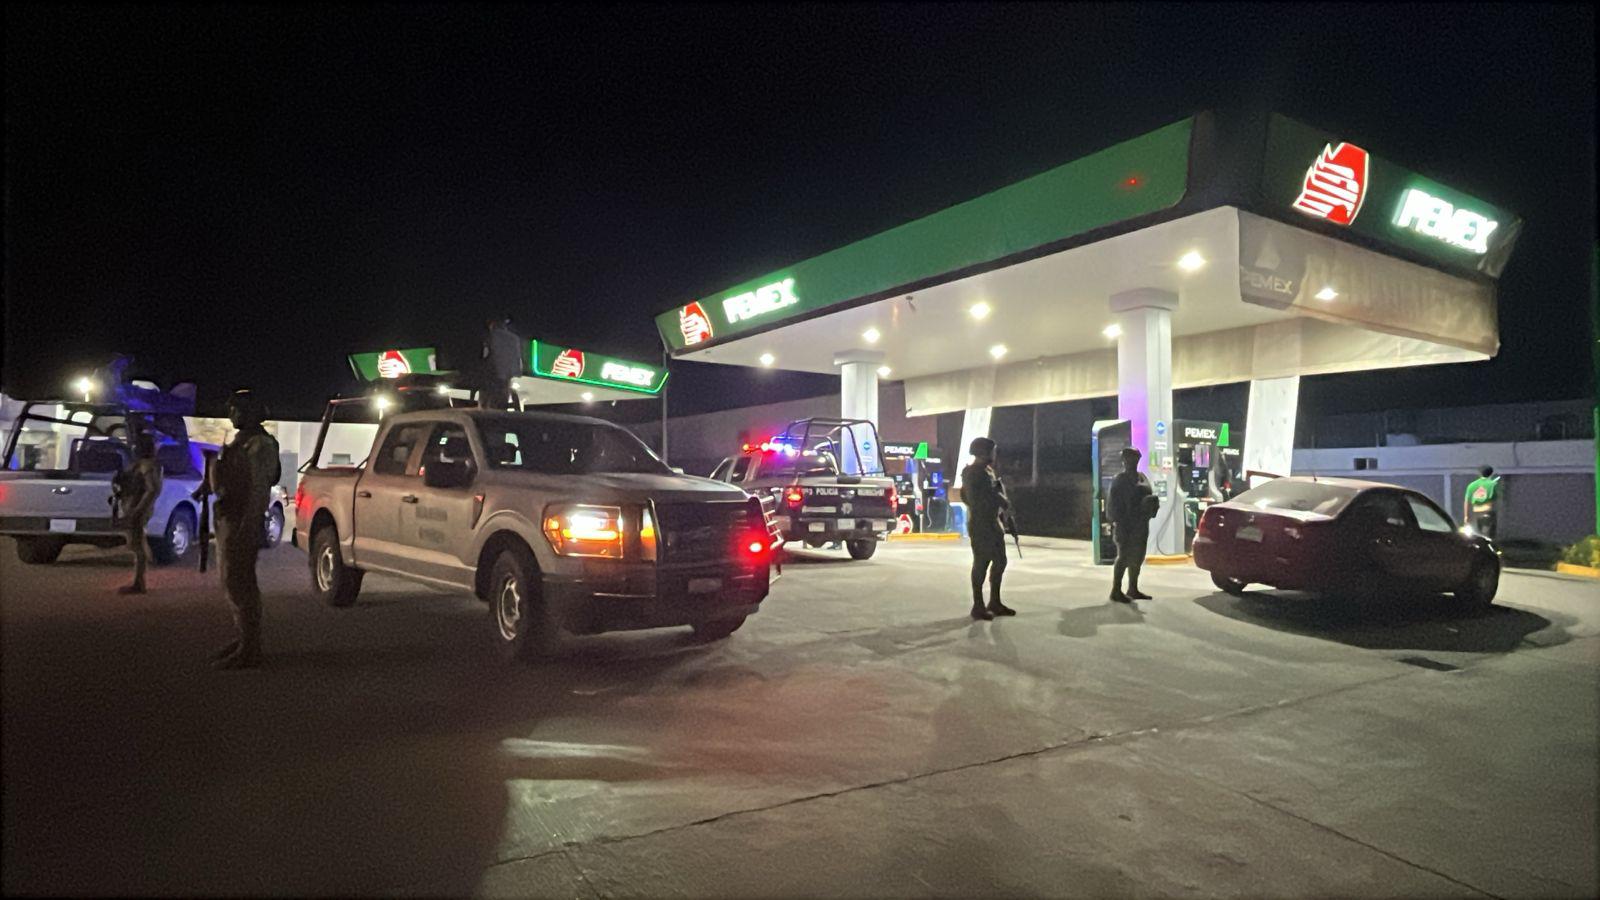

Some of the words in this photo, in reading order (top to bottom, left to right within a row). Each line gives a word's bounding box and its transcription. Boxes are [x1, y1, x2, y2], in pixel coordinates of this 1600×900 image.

[1393, 188, 1498, 254] PEMEX
[722, 277, 799, 324] PEMEX
[601, 361, 655, 386] PEMEX
[1185, 427, 1216, 439] PEMEX
